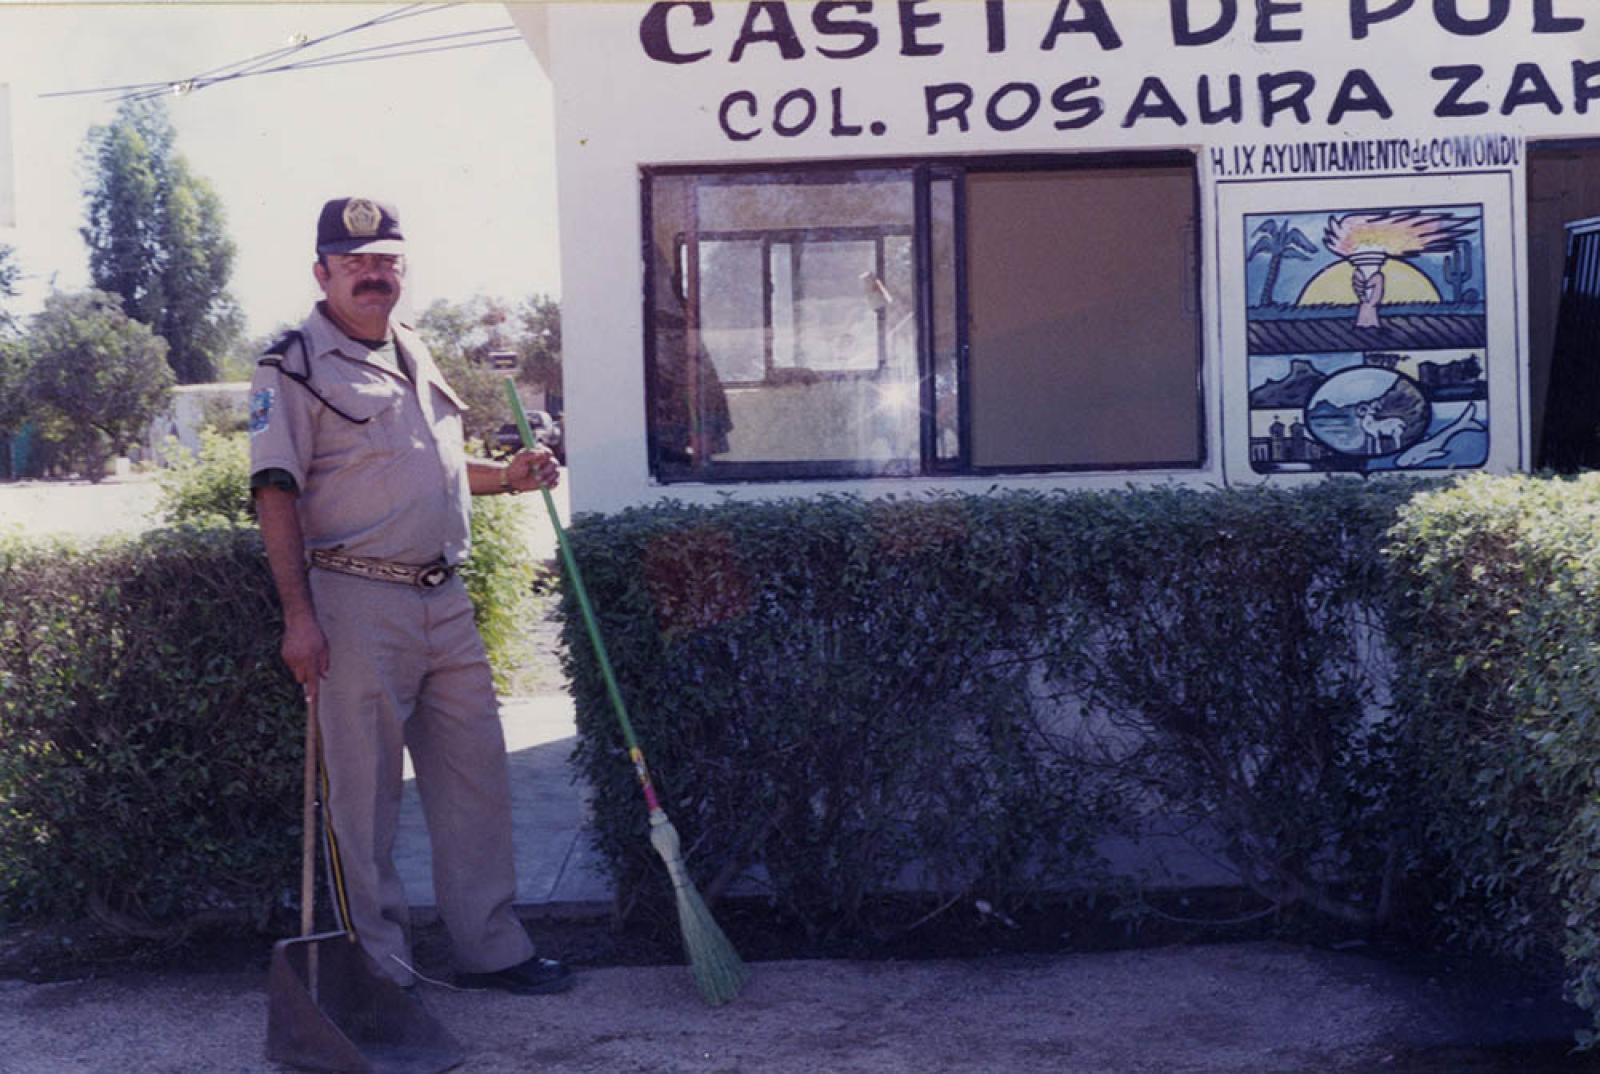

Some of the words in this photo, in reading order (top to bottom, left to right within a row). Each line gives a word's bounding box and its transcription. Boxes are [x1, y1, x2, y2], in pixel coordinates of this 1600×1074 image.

[639, 0, 1123, 65] CASETA
[1170, 0, 1303, 47] DE
[718, 87, 887, 142] COL.
[924, 68, 1393, 136] ROSAURA
[1261, 138, 1410, 174] AYUNTAMIENTO
